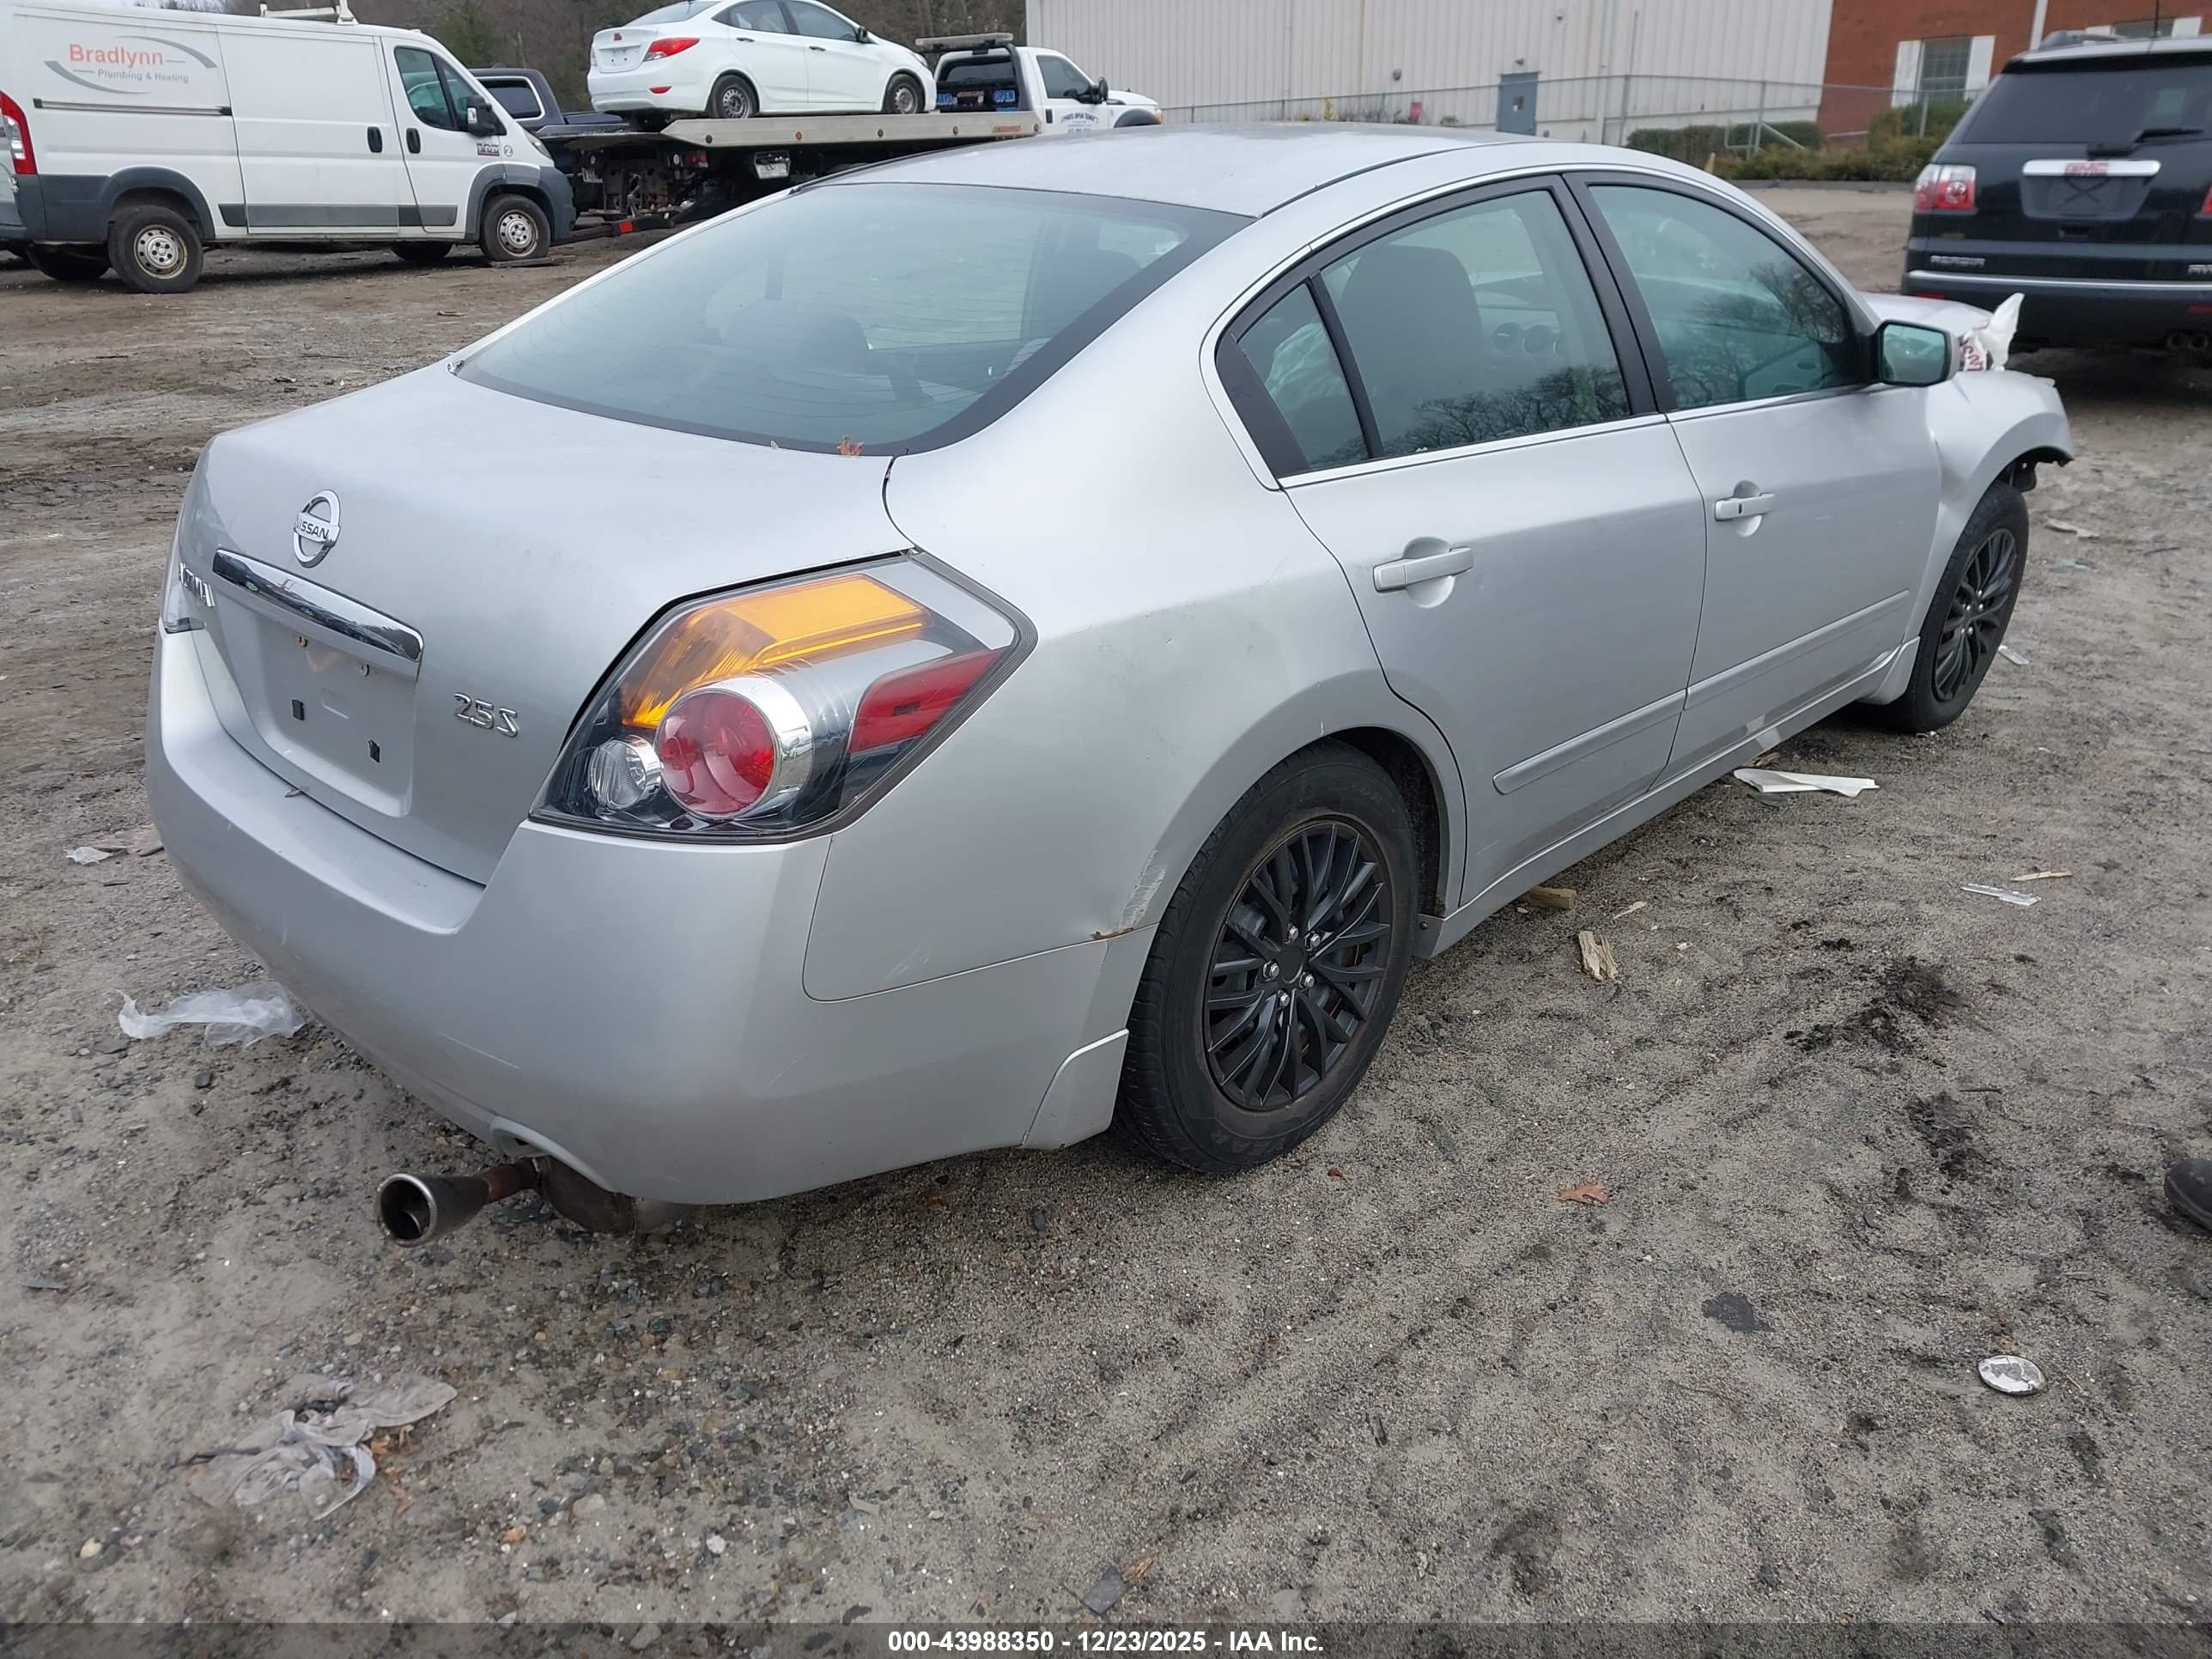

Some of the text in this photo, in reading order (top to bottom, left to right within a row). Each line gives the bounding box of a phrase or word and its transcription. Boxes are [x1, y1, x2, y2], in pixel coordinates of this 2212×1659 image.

[69, 44, 164, 68] Bradlynn
[97, 68, 143, 82] Plumbing
[155, 73, 189, 83] Heating
[2064, 162, 2108, 175] GMC
